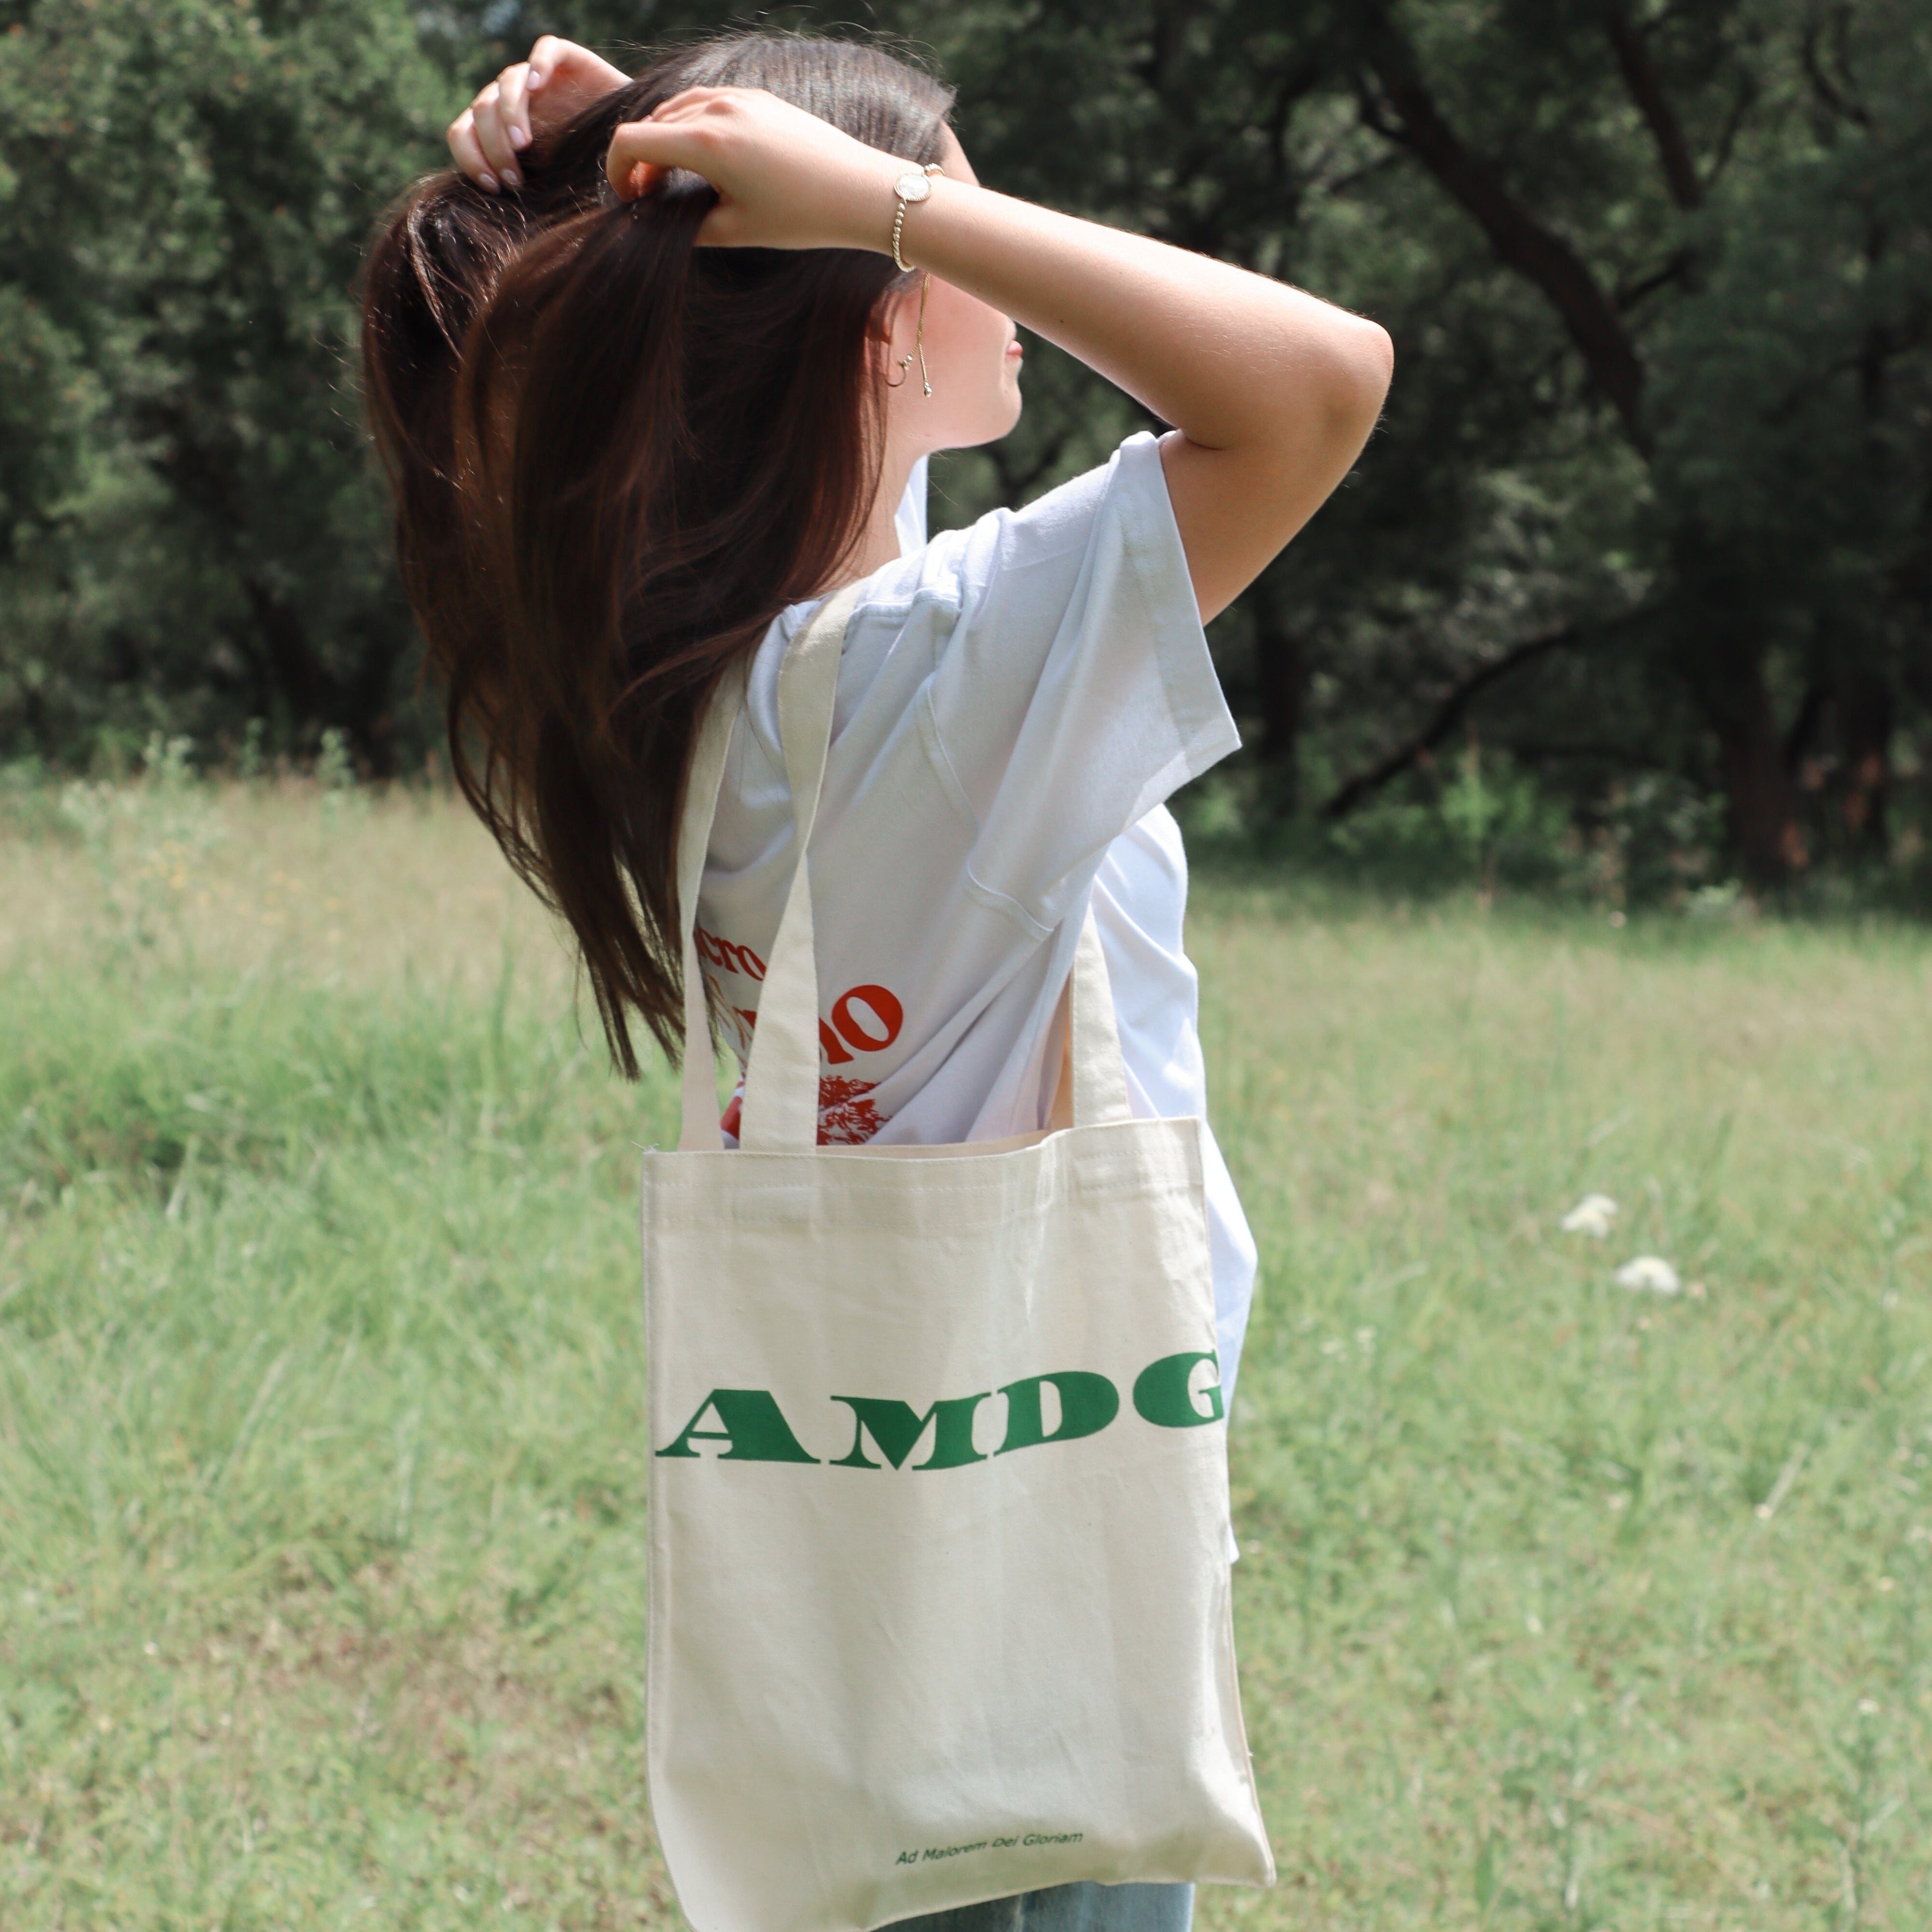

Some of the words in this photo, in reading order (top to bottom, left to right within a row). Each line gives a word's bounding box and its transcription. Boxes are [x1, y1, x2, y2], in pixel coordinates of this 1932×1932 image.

[655, 1349, 1225, 1471] AMDG
[895, 1849, 919, 1865] Ad
[922, 1841, 987, 1861] Maiorem
[992, 1834, 1019, 1847] Dei
[1023, 1833, 1084, 1846] Gloriam
